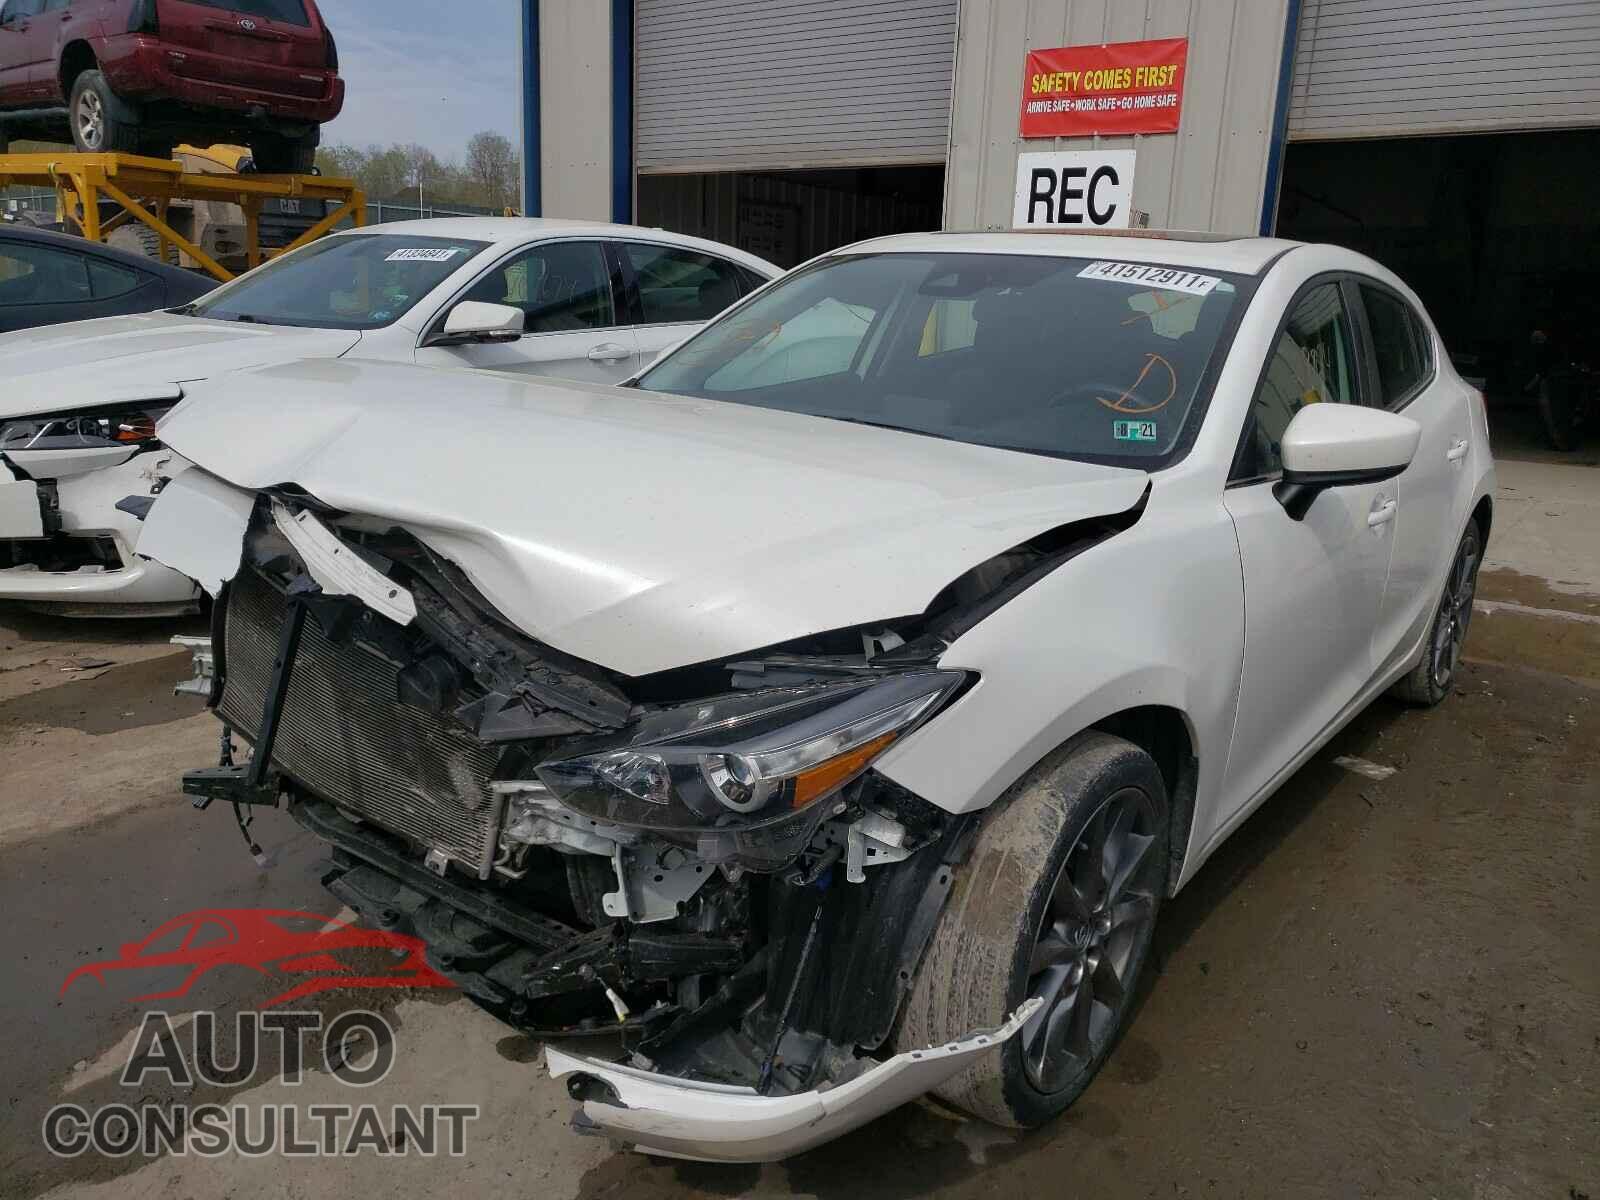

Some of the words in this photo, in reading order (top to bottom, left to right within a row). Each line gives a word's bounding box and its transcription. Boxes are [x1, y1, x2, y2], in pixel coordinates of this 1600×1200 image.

[1031, 71, 1081, 93] SAFETY
[1084, 67, 1132, 90] COMES
[1135, 64, 1177, 88] FIRST
[1026, 101, 1052, 114] ARRIVE
[1098, 97, 1117, 110] SAFE
[1121, 96, 1132, 109] GO
[1134, 95, 1156, 108] HOME
[1156, 94, 1177, 107] SAFE
[1027, 165, 1120, 225] REC
[1142, 423, 1155, 437] 21
